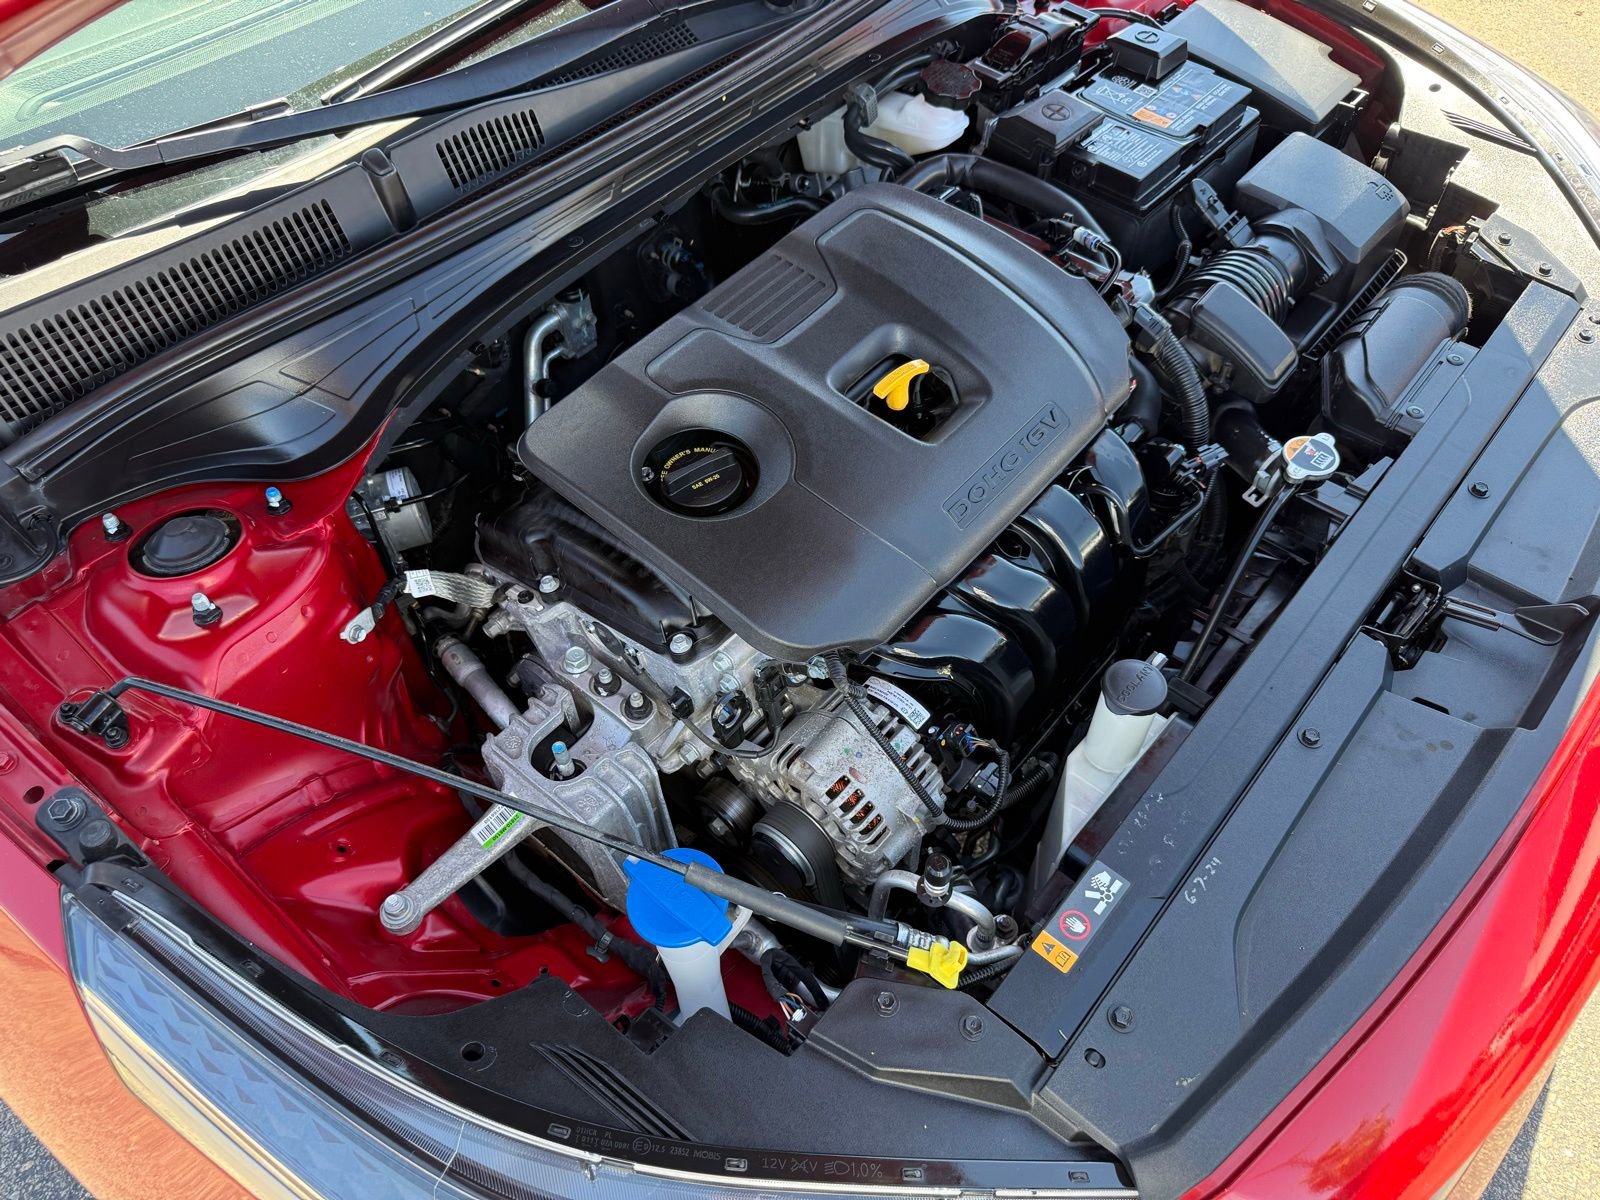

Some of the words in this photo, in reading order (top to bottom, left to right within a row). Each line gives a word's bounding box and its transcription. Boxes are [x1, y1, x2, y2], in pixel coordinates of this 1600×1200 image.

[663, 449, 691, 469] OWNER'S
[692, 482, 704, 490] SAE
[948, 450, 1020, 523] DOHC
[1116, 663, 1154, 702] COOLANT
[693, 1150, 722, 1160] MOBIS
[762, 1158, 786, 1170] 12V
